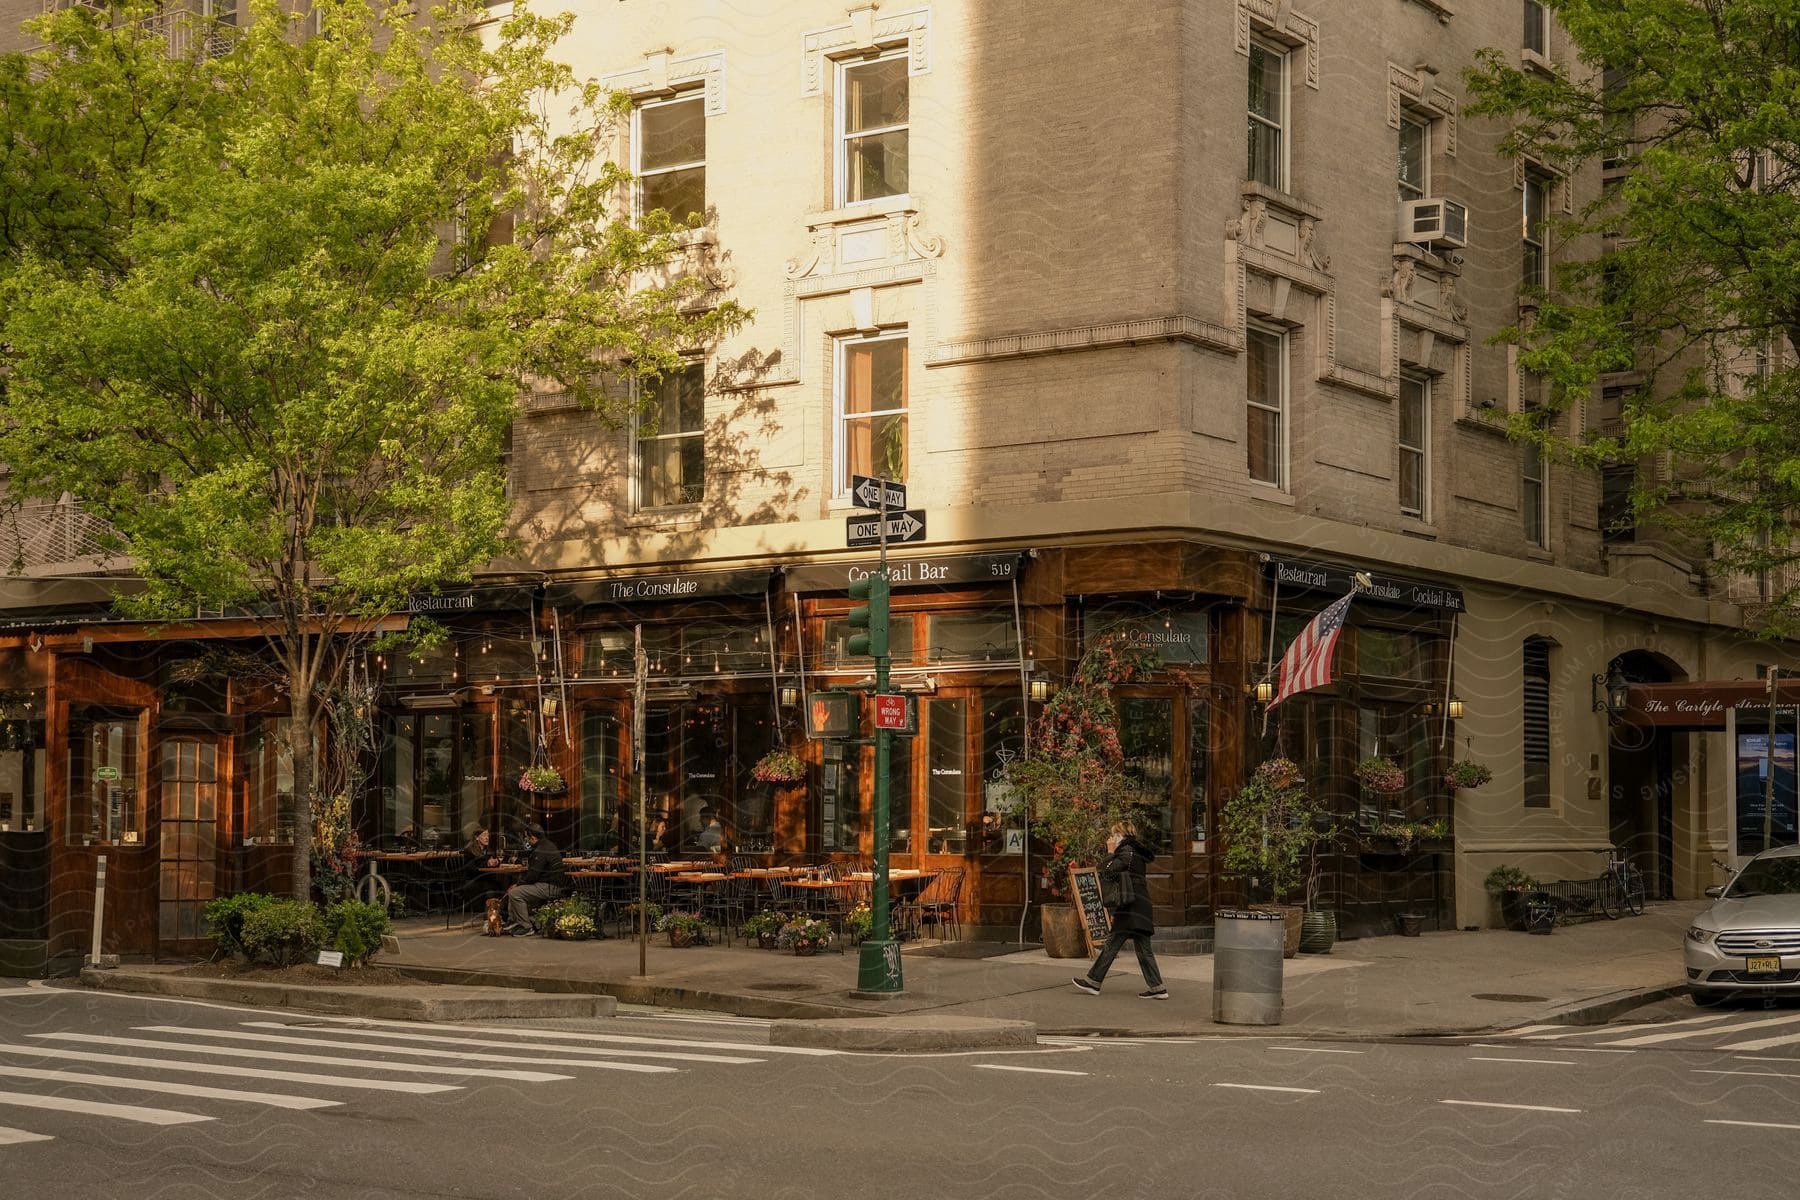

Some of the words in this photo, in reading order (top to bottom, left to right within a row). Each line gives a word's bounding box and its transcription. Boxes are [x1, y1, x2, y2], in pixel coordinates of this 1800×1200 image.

[863, 487, 878, 501] ONE
[886, 491, 901, 505] WAY
[857, 524, 878, 537] ONE
[892, 521, 914, 534] WAY
[848, 563, 913, 582] Cotail
[919, 562, 949, 580] Bar
[991, 564, 1011, 576] 519
[611, 582, 634, 598] The
[636, 578, 698, 597] Consulate
[1278, 563, 1327, 588] Restaurant
[1412, 586, 1444, 606] Cocktail
[1445, 591, 1460, 609] Bar
[409, 594, 474, 612] Restaurant
[1129, 629, 1191, 643] Consulate
[881, 707, 901, 717] WRONG
[1645, 699, 1669, 712] The
[1675, 699, 1723, 717] Carlyle
[885, 716, 897, 725] WAY
[1009, 833, 1020, 847] A
